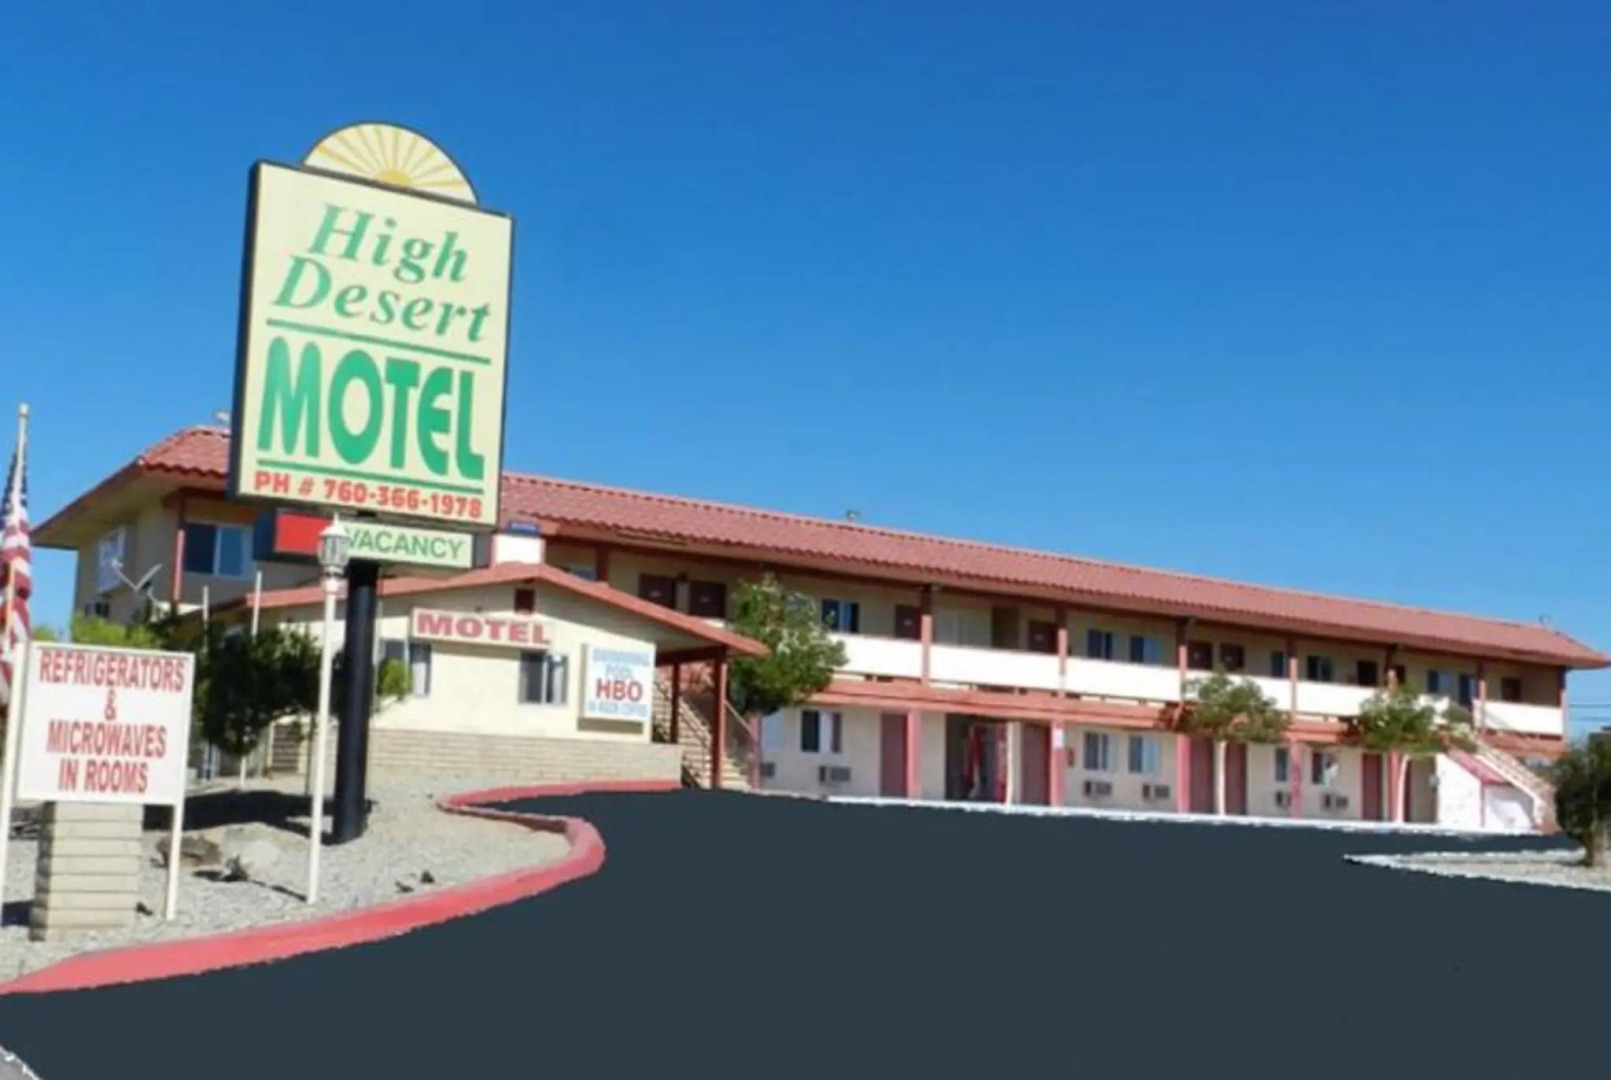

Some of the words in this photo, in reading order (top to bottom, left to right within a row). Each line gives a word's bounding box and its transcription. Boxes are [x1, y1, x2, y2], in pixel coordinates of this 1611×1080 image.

[307, 203, 468, 284] High
[271, 255, 491, 342] Desert
[257, 336, 485, 480] MOTEL
[254, 470, 290, 494] PH
[298, 477, 315, 495] #
[324, 480, 483, 518] 760-366-1978
[346, 527, 464, 558] VACANCY
[416, 613, 550, 644] MOTEL
[39, 650, 185, 692] REFRIGERATORS
[596, 678, 643, 702] HBO
[104, 689, 116, 720] &
[47, 719, 167, 758] MICROWAVES
[58, 758, 78, 791] IN
[84, 760, 148, 793] ROOMS
